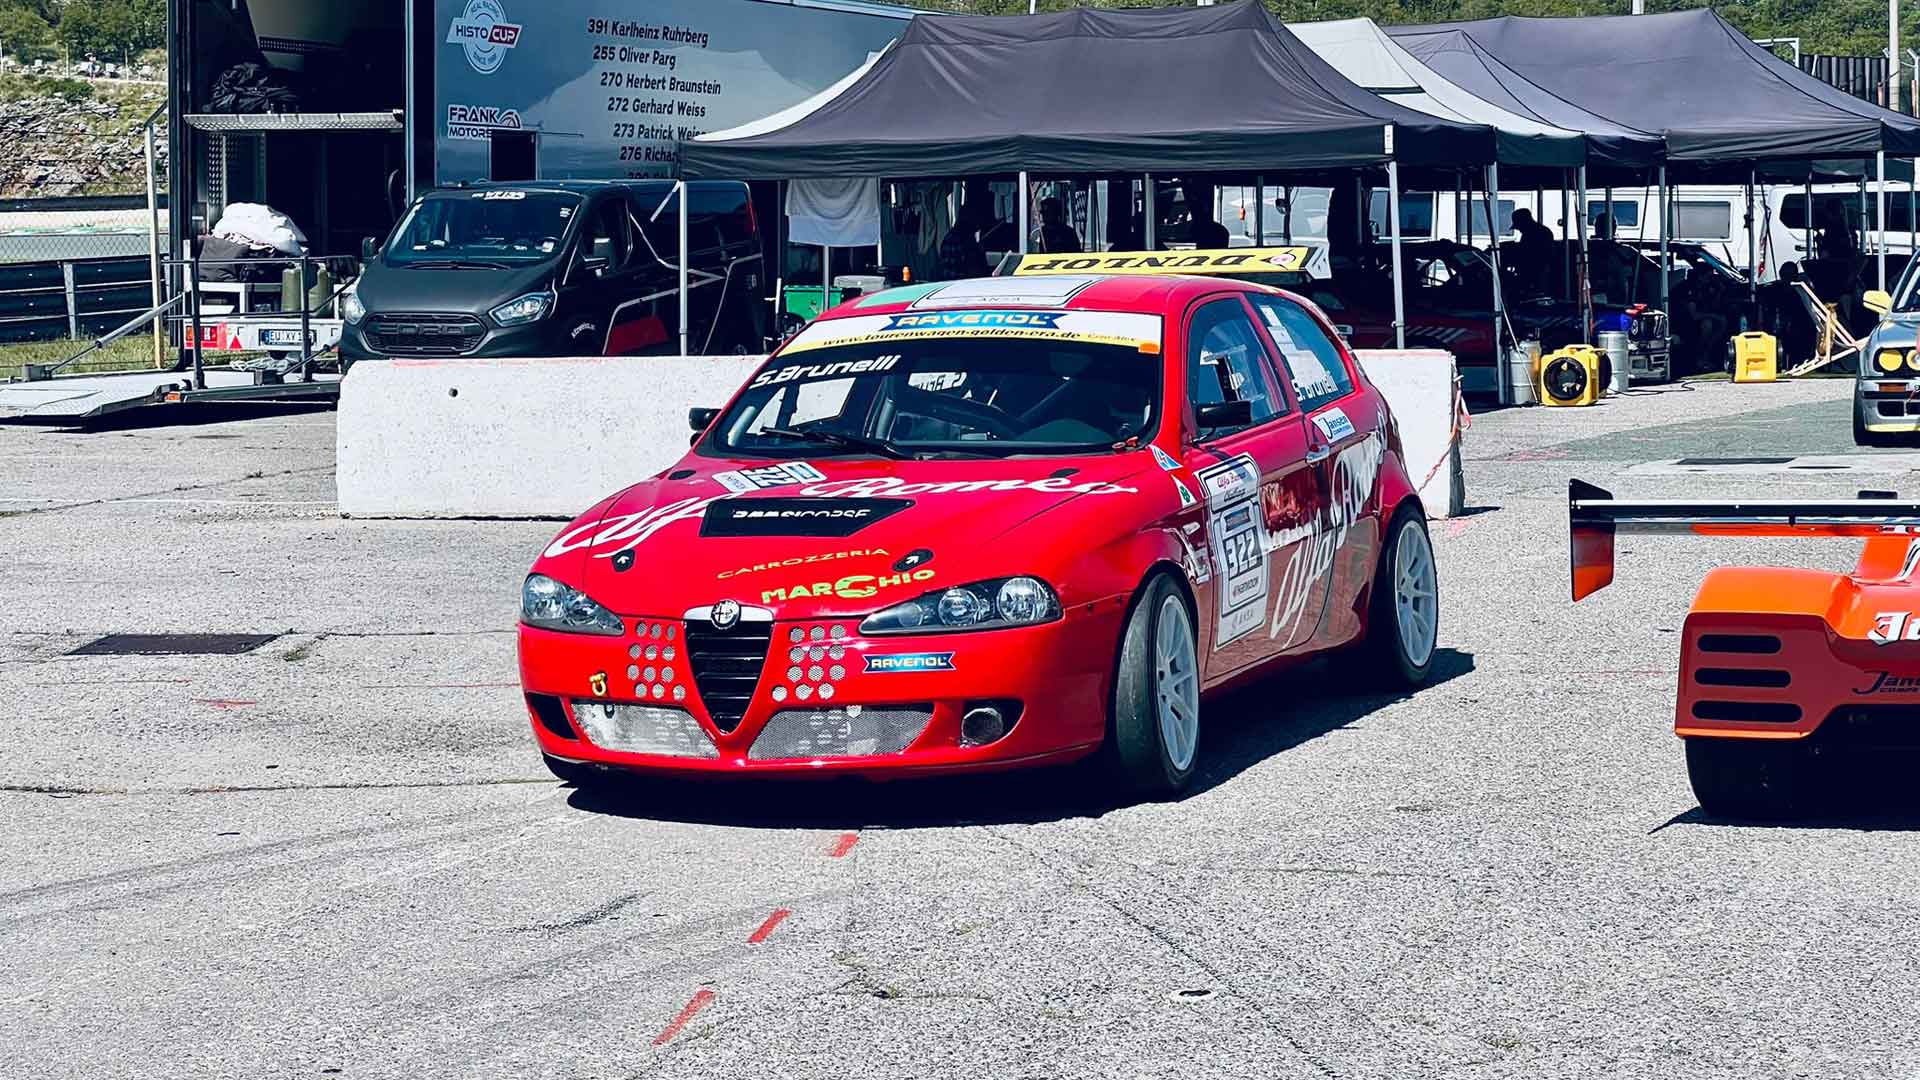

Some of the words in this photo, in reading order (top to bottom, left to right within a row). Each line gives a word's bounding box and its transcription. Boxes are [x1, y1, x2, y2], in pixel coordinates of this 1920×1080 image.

[456, 25, 489, 39] HISTO
[492, 28, 515, 42] CUP
[588, 18, 608, 35] 391
[611, 21, 660, 41] Karlheinz
[662, 25, 709, 48] Ruhrberg
[593, 46, 615, 61] 255
[619, 48, 649, 64] Oliver
[652, 50, 676, 70] Parg
[600, 72, 623, 88] 270
[626, 74, 666, 92] Herbert
[669, 79, 721, 95] Braunstein
[450, 106, 498, 123] FRANK
[608, 97, 629, 112] 272
[632, 99, 674, 116] Gerhard
[677, 101, 706, 118] Weiss
[449, 127, 493, 138] MOTORS
[613, 123, 635, 138] 273
[637, 124, 674, 141] Patrick
[620, 146, 642, 161] 276
[1023, 254, 1255, 271] DUNLOP
[544, 491, 745, 559] Alf
[1224, 528, 1260, 578] 322
[717, 548, 889, 580] CARROZZERIA
